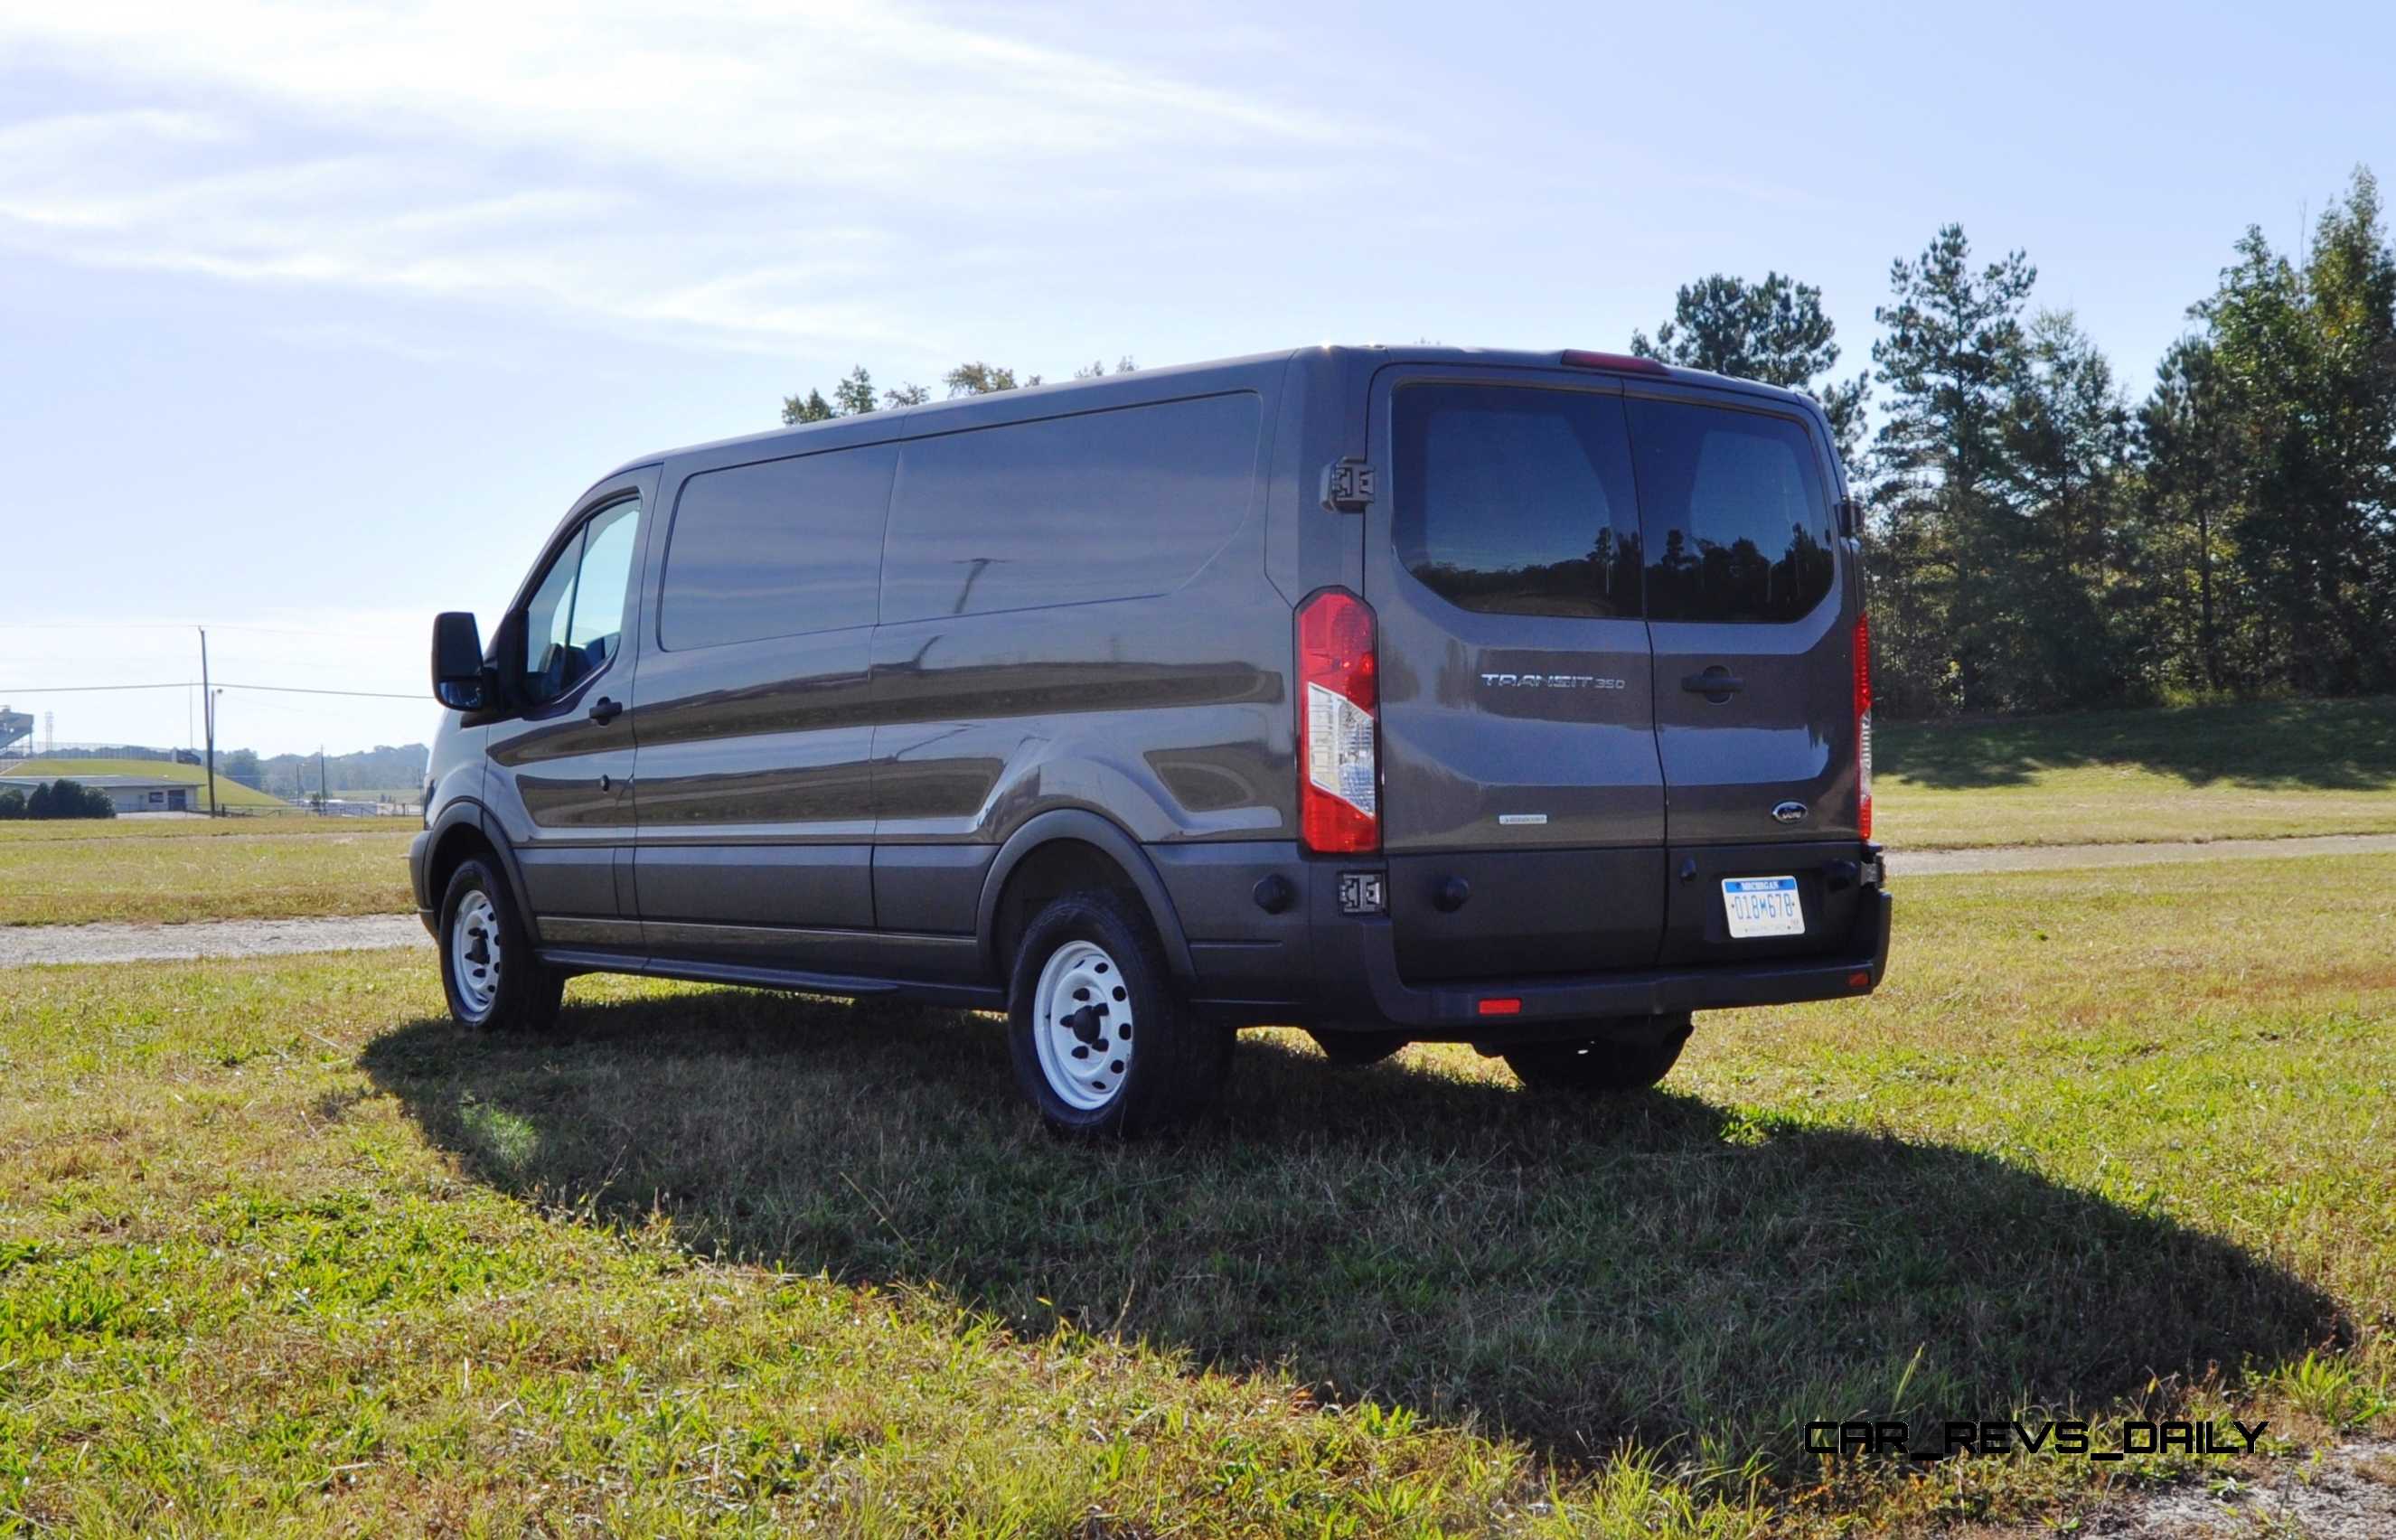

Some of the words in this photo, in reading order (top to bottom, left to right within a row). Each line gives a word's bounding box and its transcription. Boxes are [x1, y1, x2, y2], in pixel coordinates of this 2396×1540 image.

[1480, 673, 1593, 688] TRANSIT
[1594, 678, 1626, 689] 350
[1741, 880, 1780, 891] MICHIGAN
